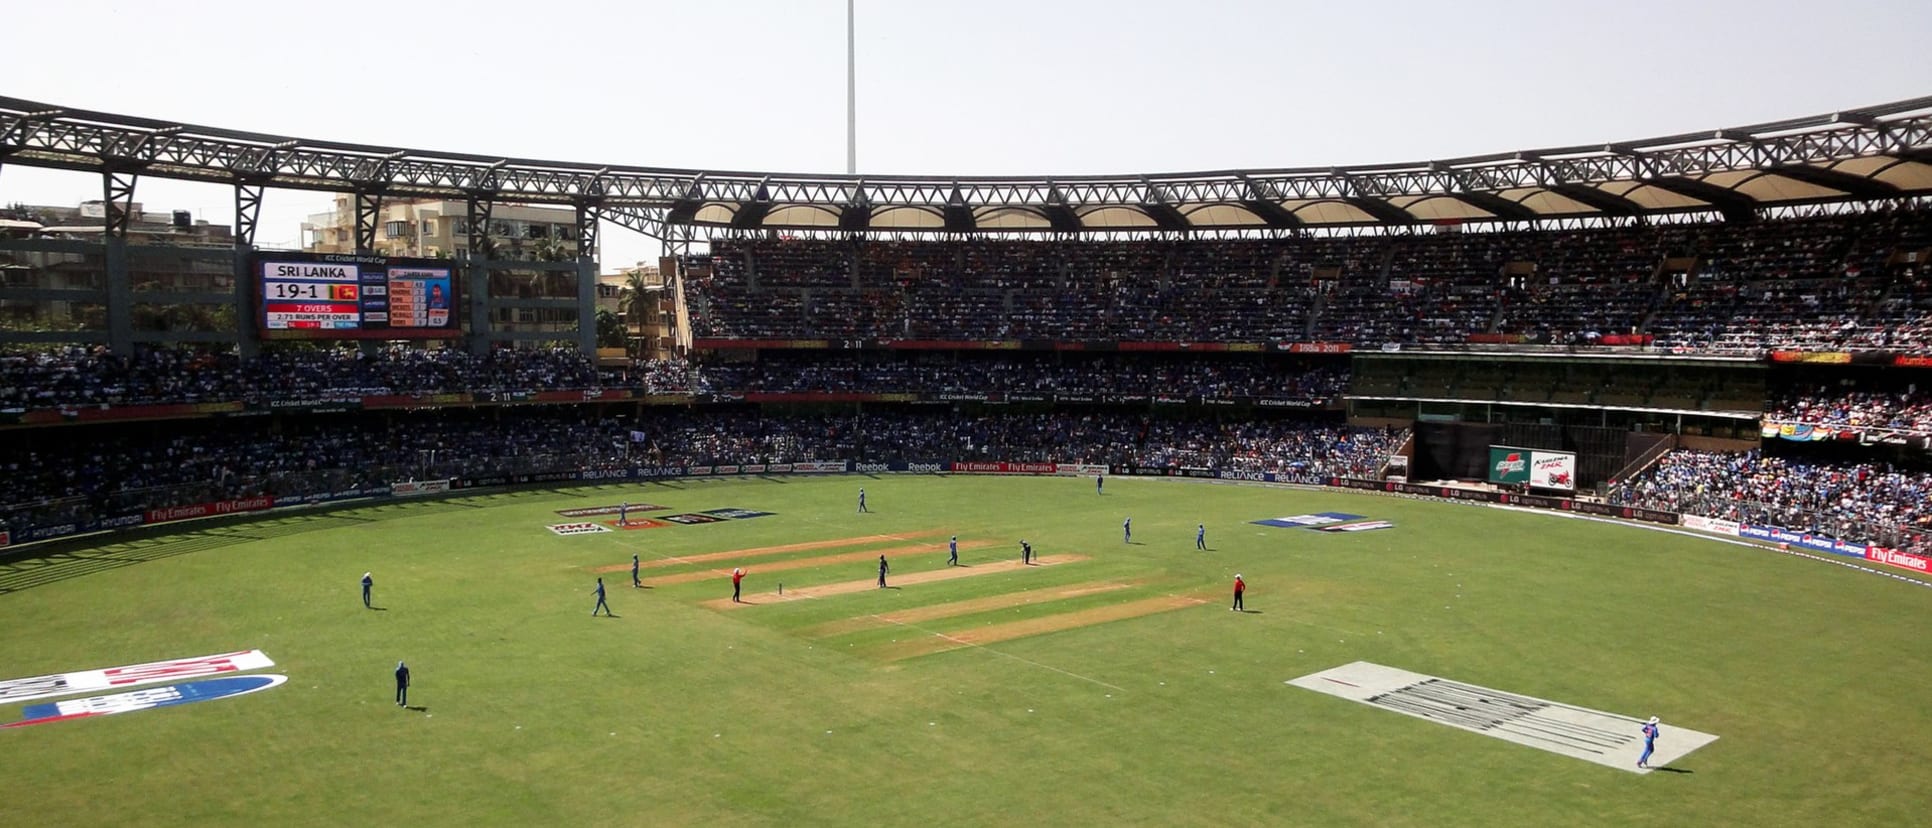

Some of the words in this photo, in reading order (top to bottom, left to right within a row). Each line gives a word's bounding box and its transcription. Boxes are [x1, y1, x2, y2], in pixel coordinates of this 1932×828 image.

[278, 265, 300, 277] SRI
[304, 266, 346, 278] LANKA
[275, 284, 318, 299] 19-1
[855, 462, 889, 472] Reebok
[908, 462, 942, 472] Reebok
[955, 463, 967, 472] Fly
[969, 463, 1000, 471] Emirates
[1008, 463, 1020, 472] Fly
[1021, 463, 1052, 472] Emirates
[232, 498, 268, 510] Emirates
[168, 505, 206, 518] Emirates
[1871, 548, 1886, 563] Fly
[1888, 551, 1927, 569] Emirates
